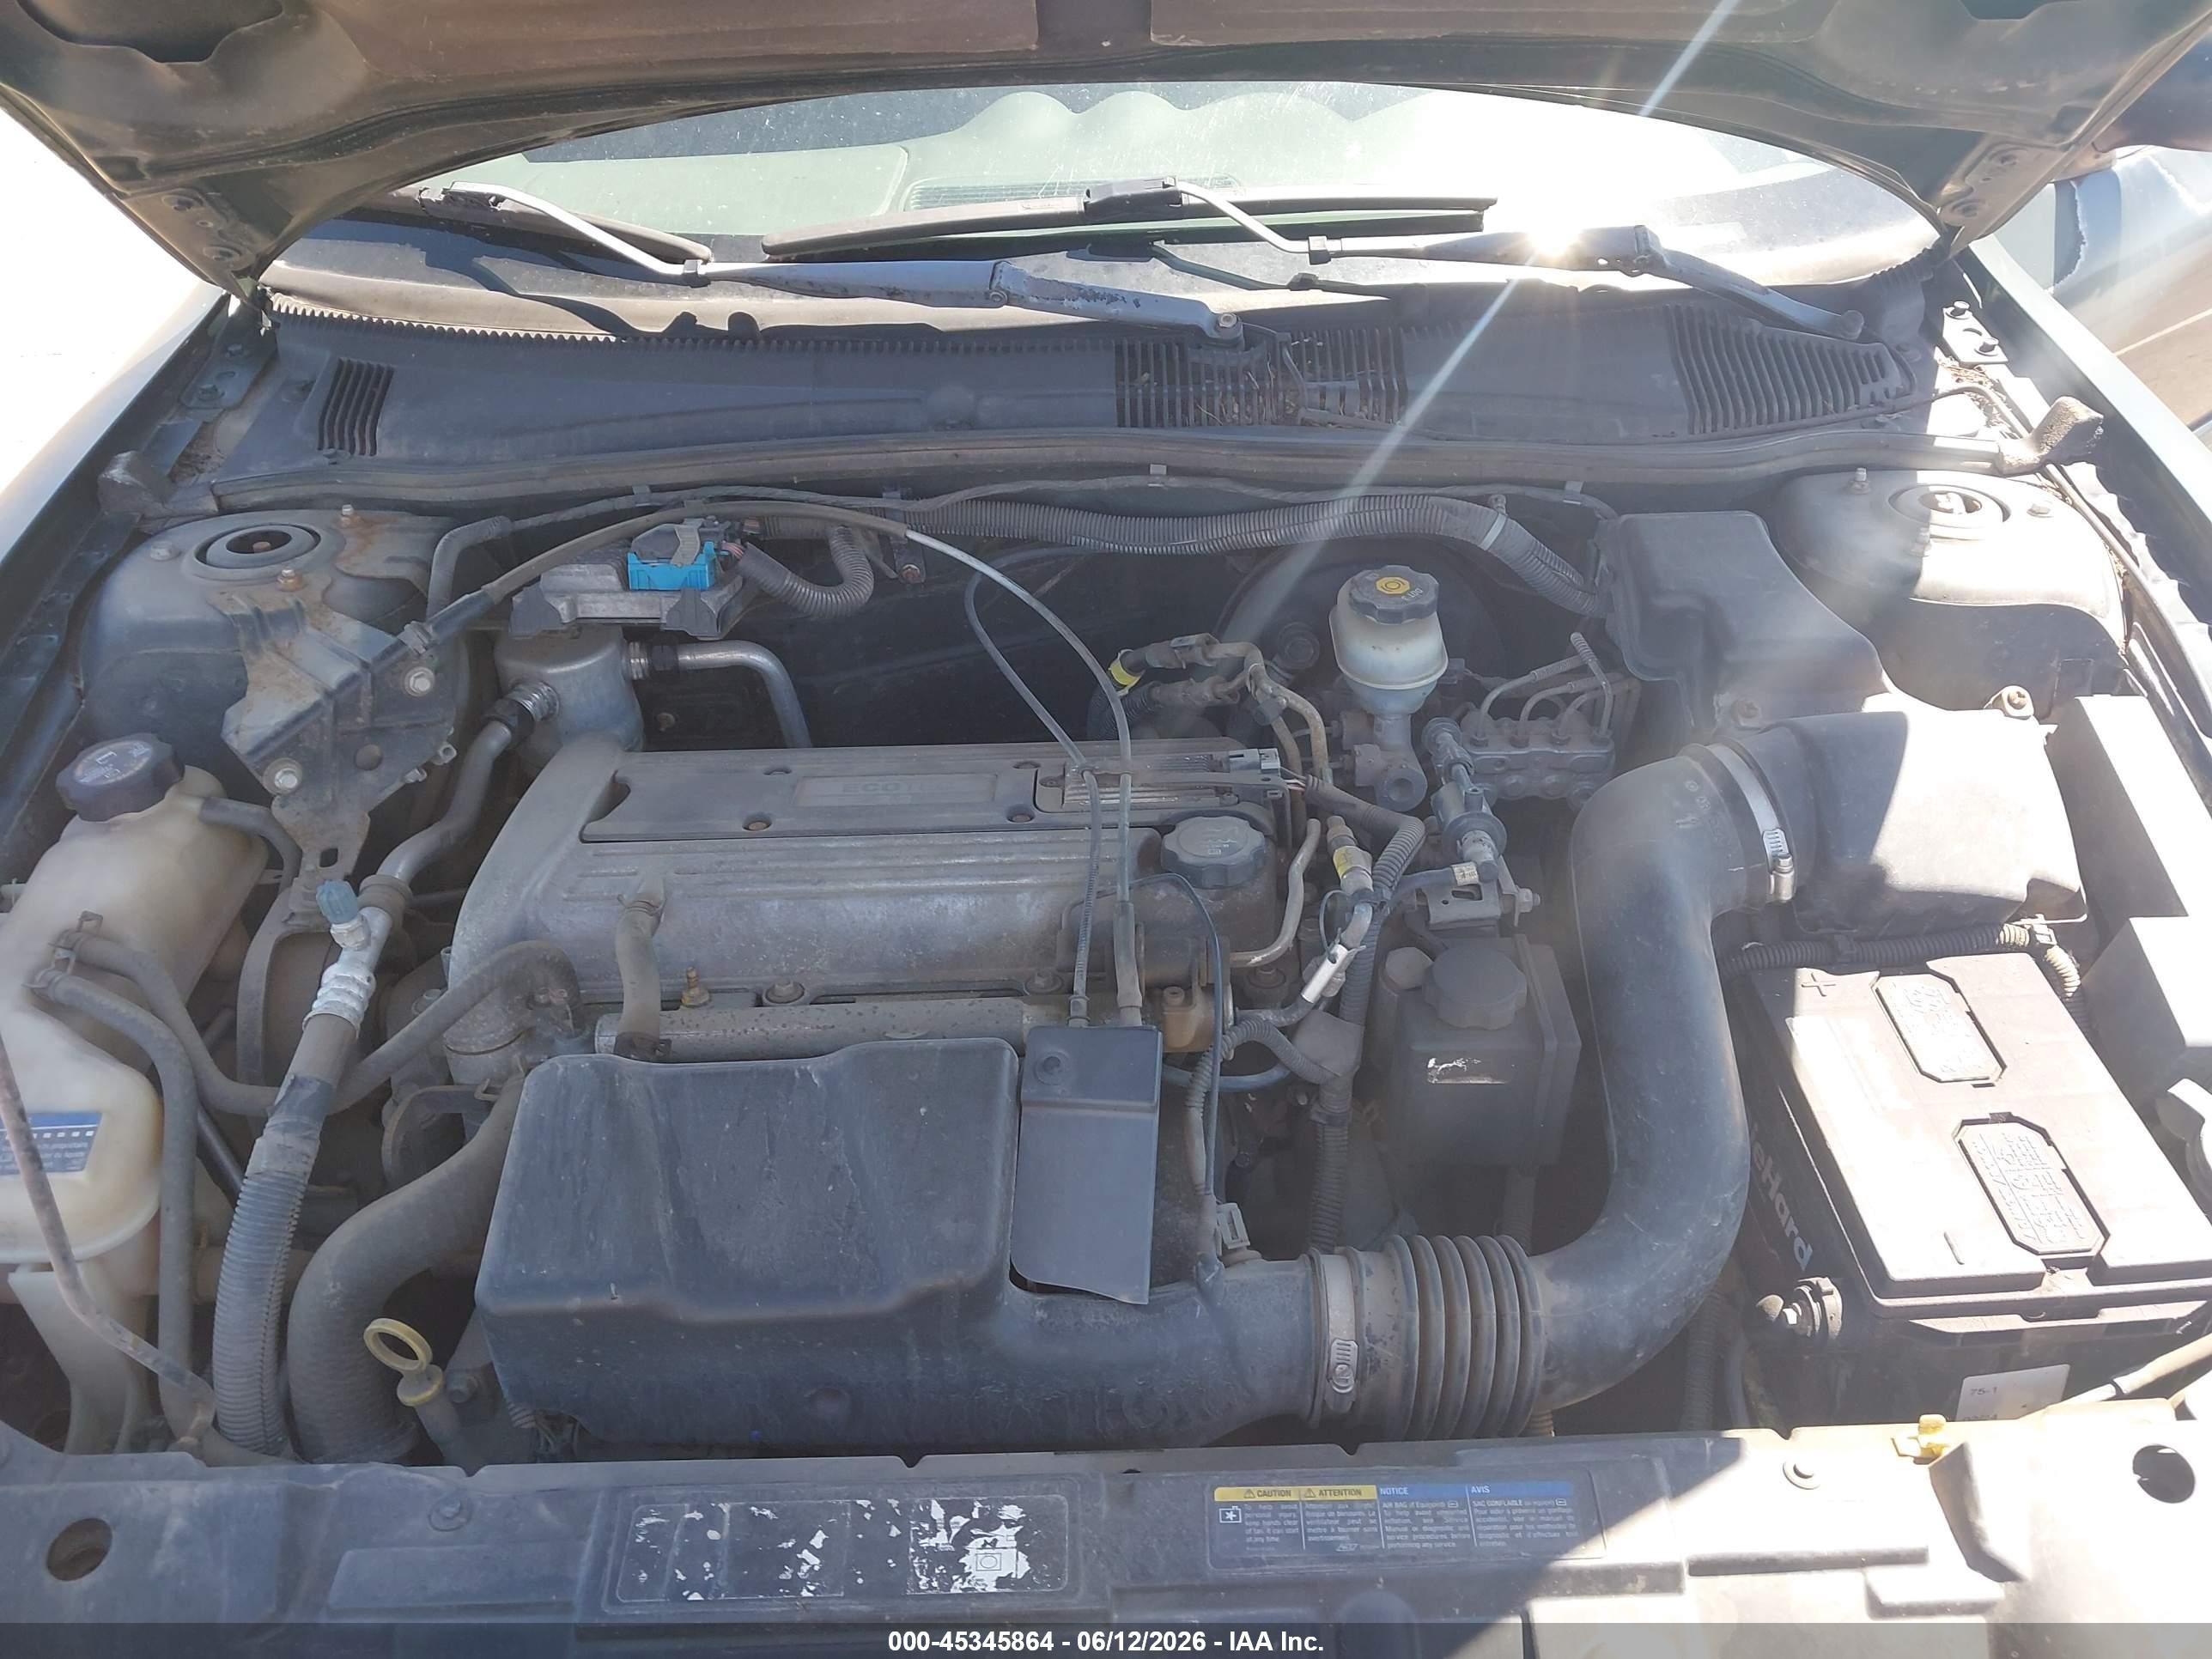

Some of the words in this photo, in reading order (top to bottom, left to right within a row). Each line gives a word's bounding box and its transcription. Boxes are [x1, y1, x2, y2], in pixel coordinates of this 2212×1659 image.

[1256, 1489, 1291, 1498] CAUTION
[1318, 1488, 1362, 1497] ATTENTION
[1380, 1486, 1409, 1495] NOTICE
[1471, 1486, 1491, 1494] AVIS
